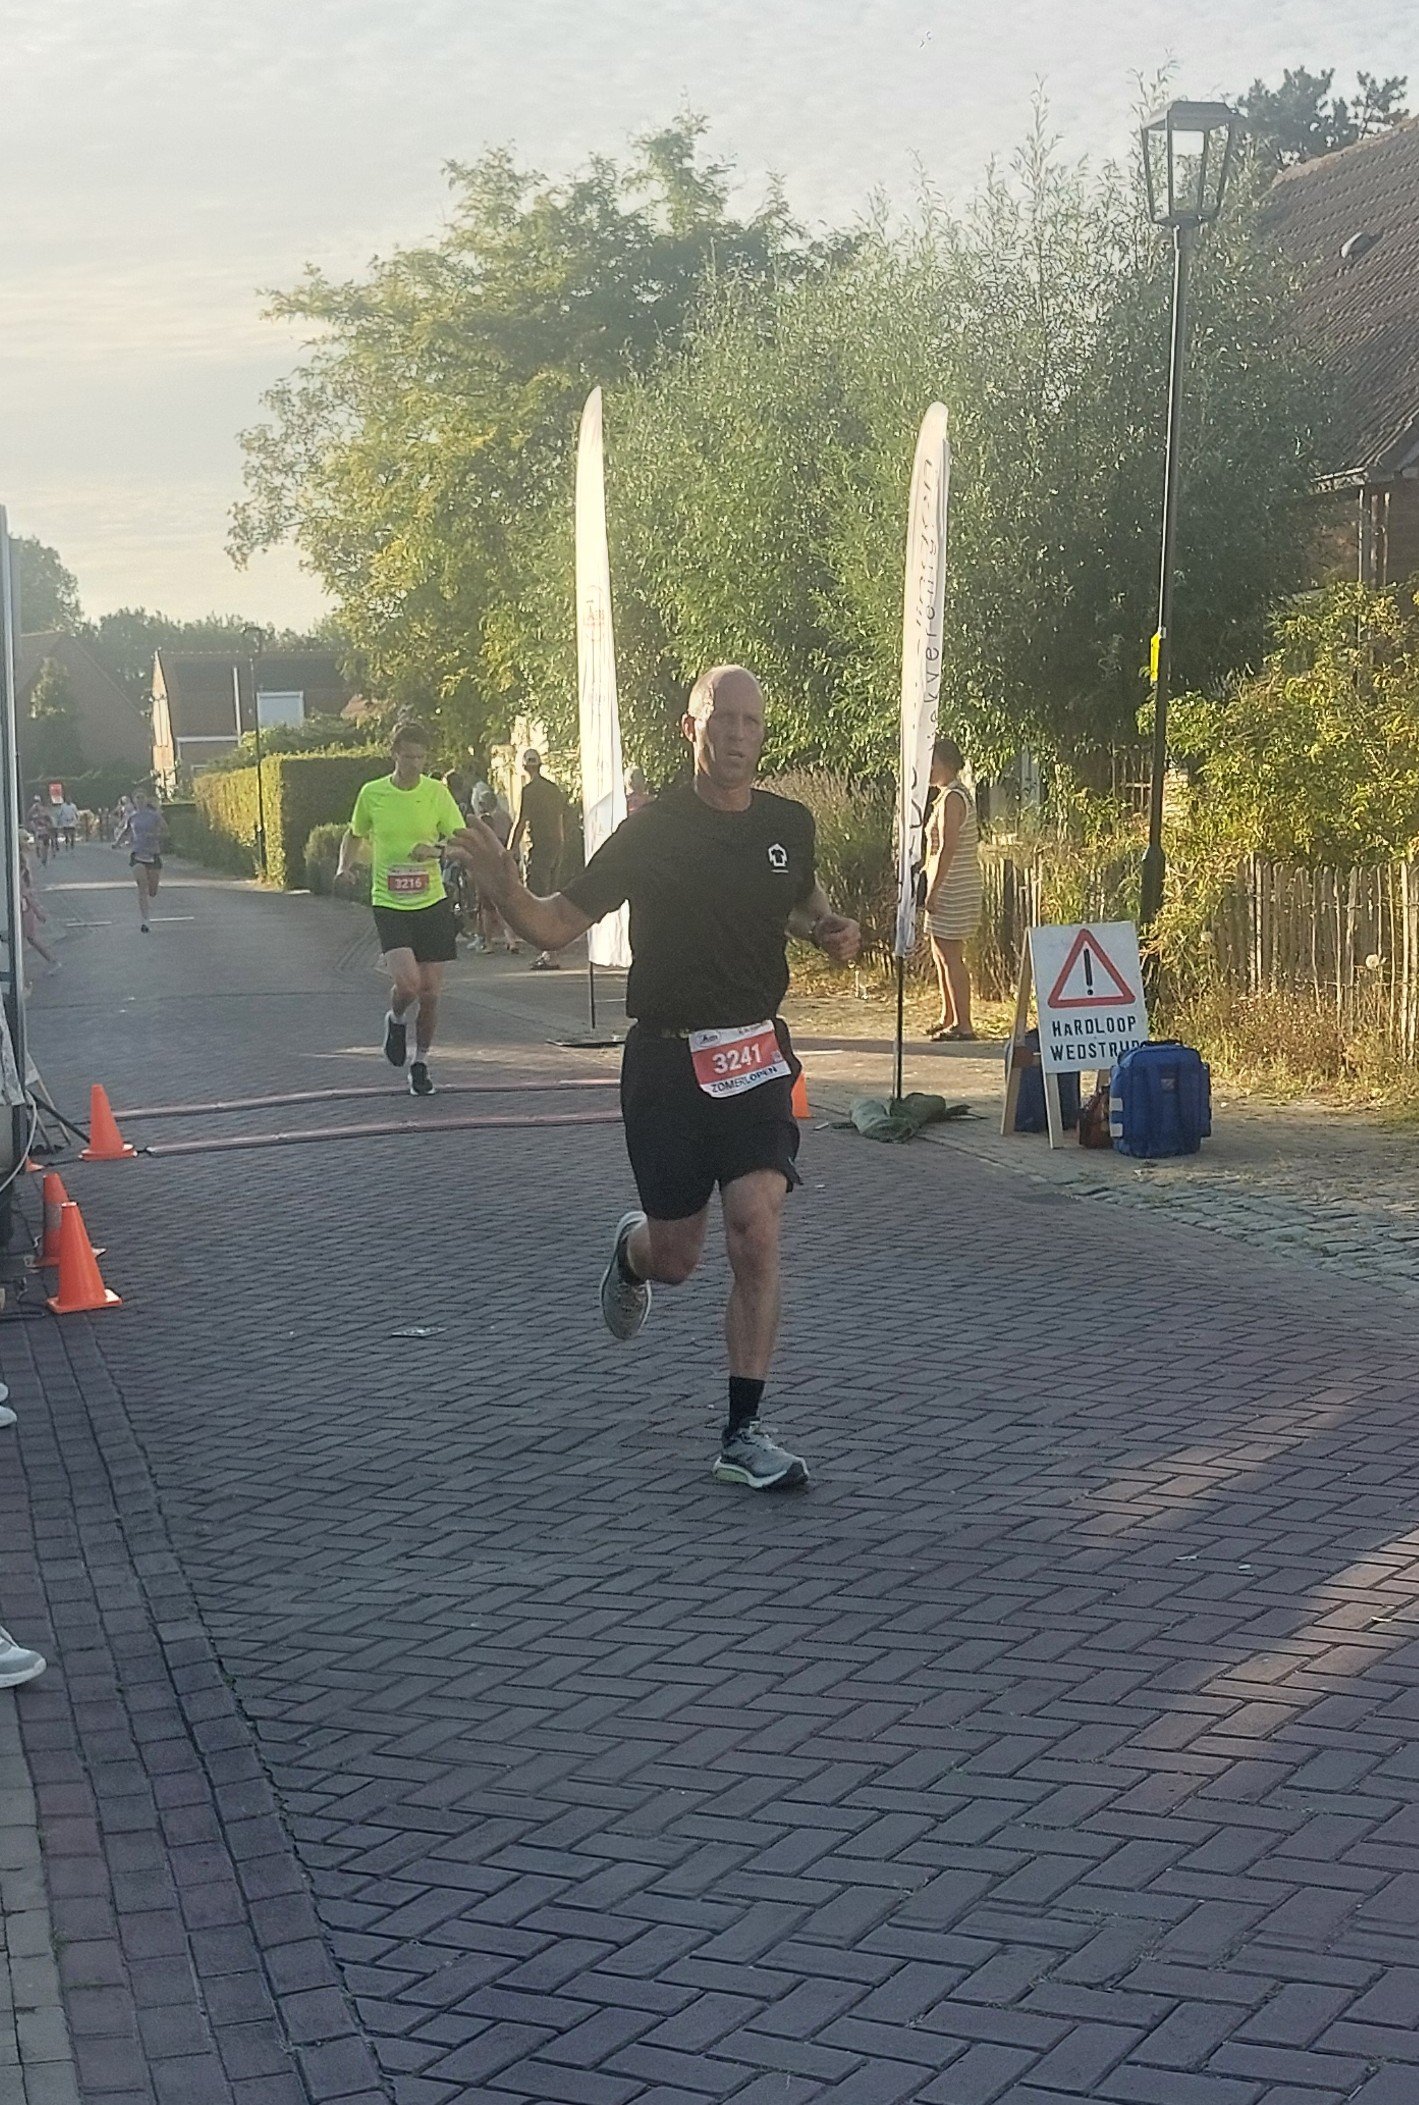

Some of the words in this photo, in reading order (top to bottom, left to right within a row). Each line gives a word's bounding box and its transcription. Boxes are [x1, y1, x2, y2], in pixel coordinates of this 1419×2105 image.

[395, 878, 422, 889] 3216
[1052, 1015, 1136, 1037] HARDLOOP
[712, 1043, 763, 1074] 3241
